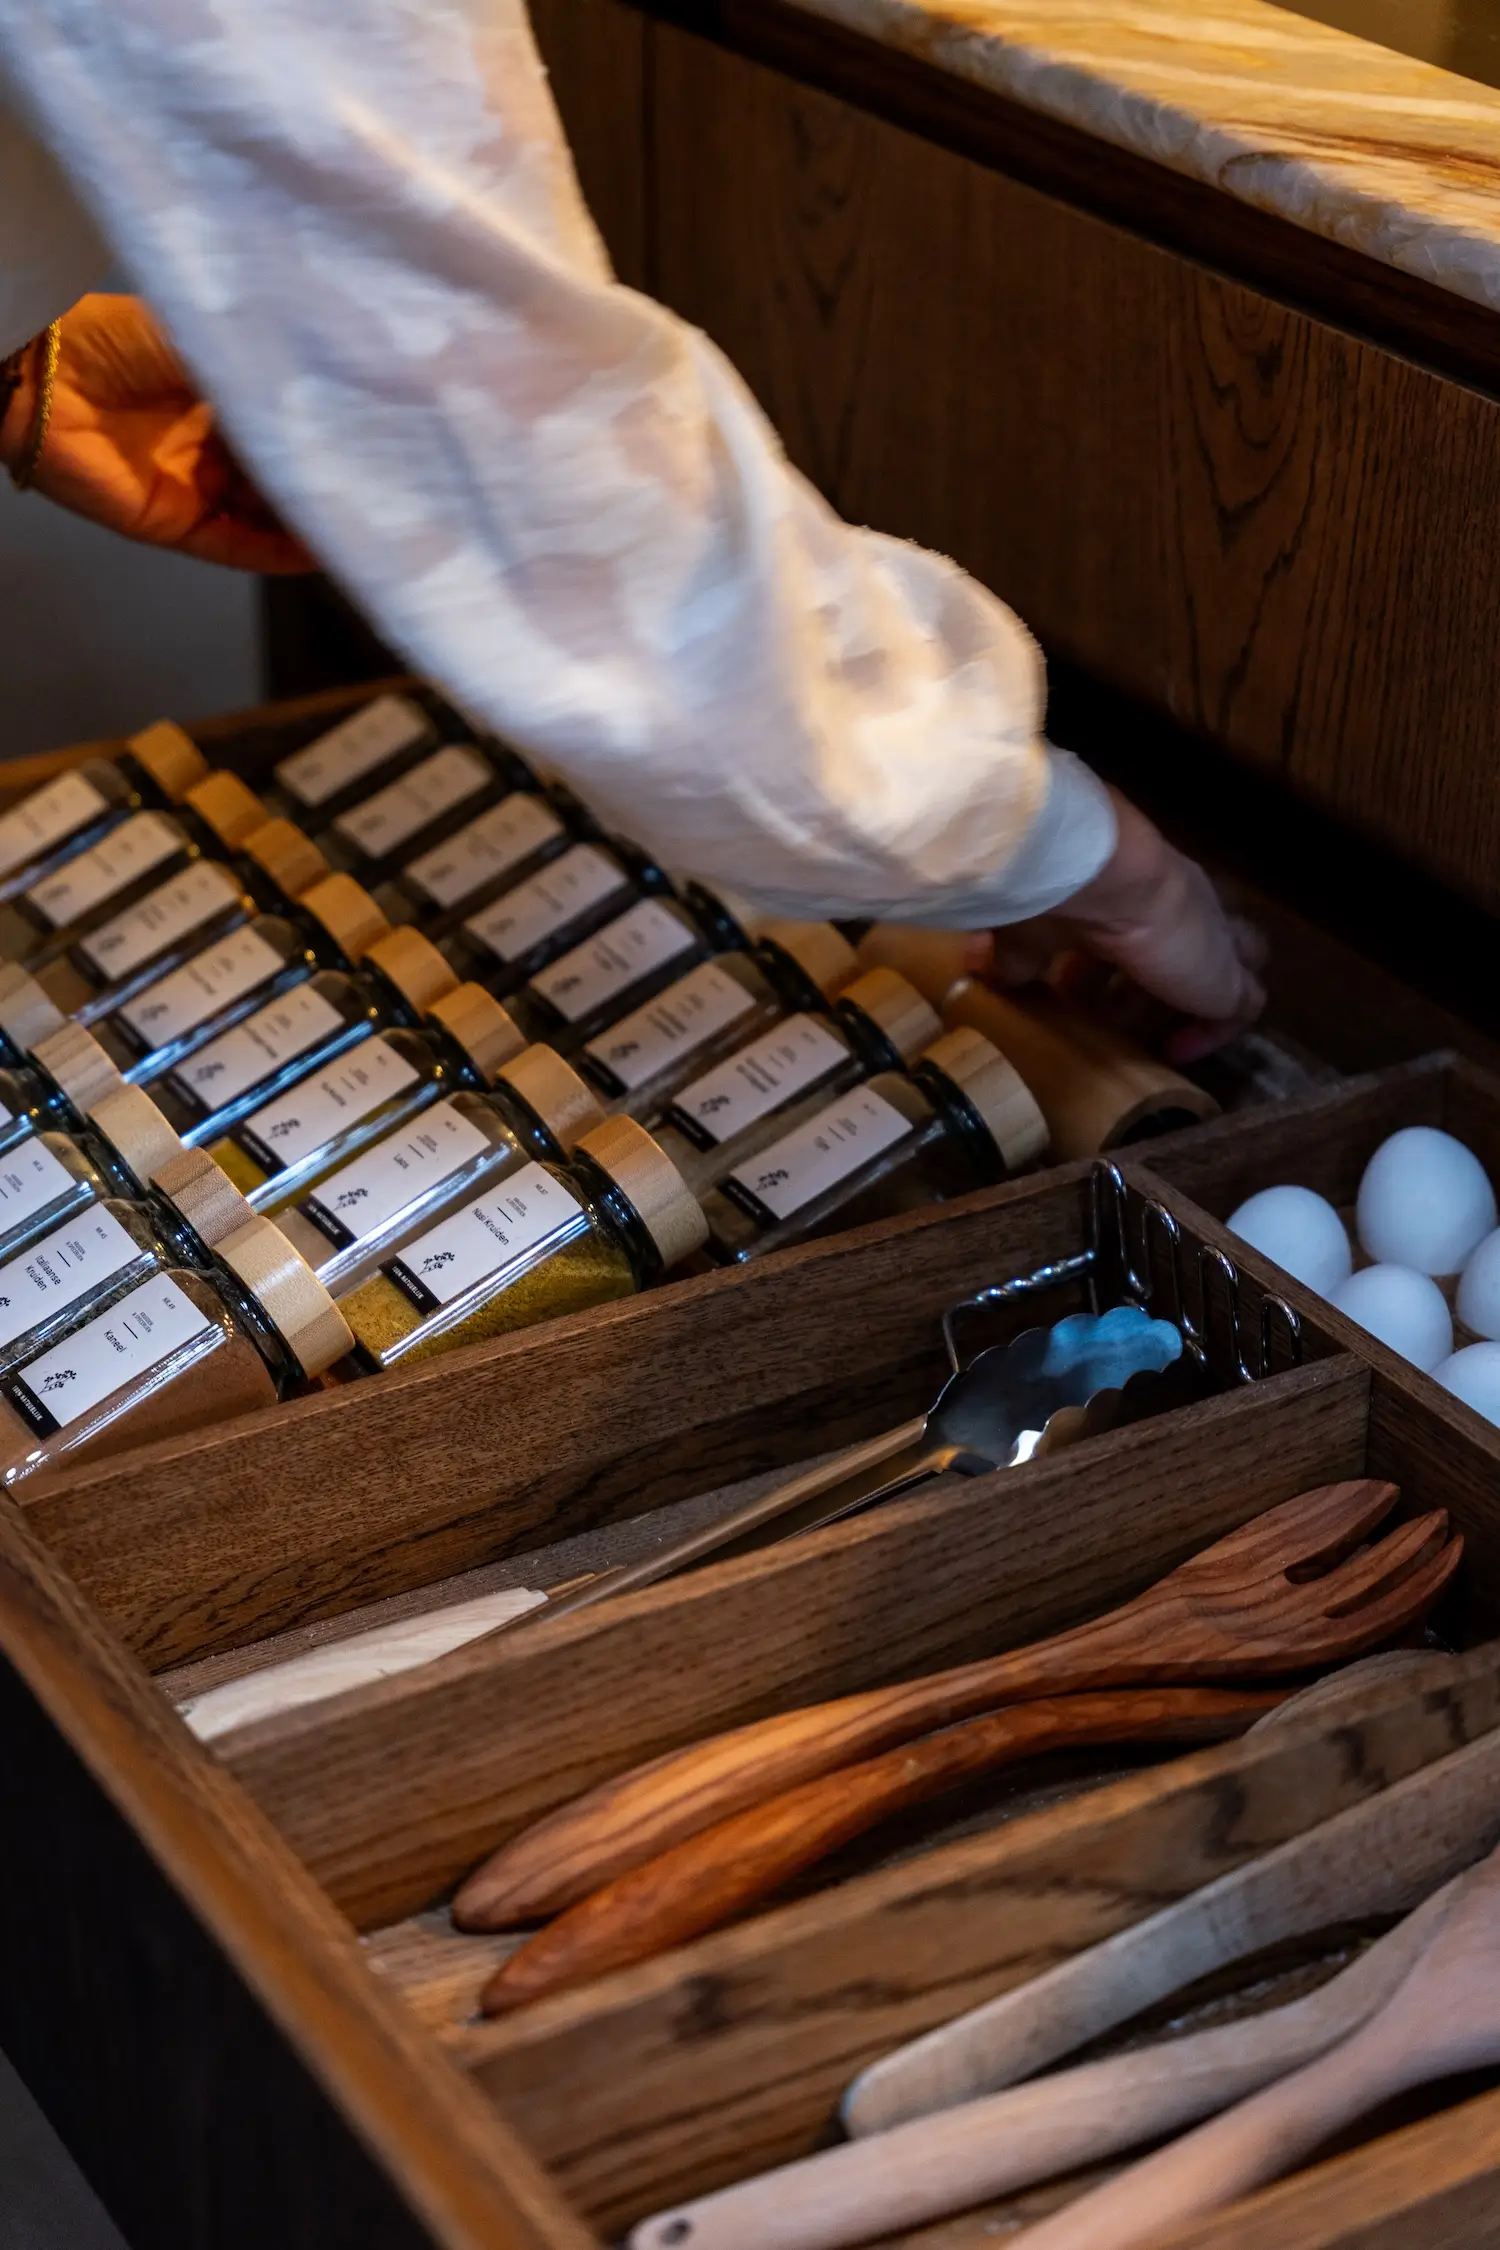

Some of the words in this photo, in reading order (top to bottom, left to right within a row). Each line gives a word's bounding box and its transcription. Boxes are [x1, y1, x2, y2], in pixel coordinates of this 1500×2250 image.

[472, 1208, 489, 1223] Nasi
[484, 1218, 510, 1246] Kruiden
[24, 1264, 48, 1292] Kruiden
[103, 1329, 128, 1353] Kaneel
